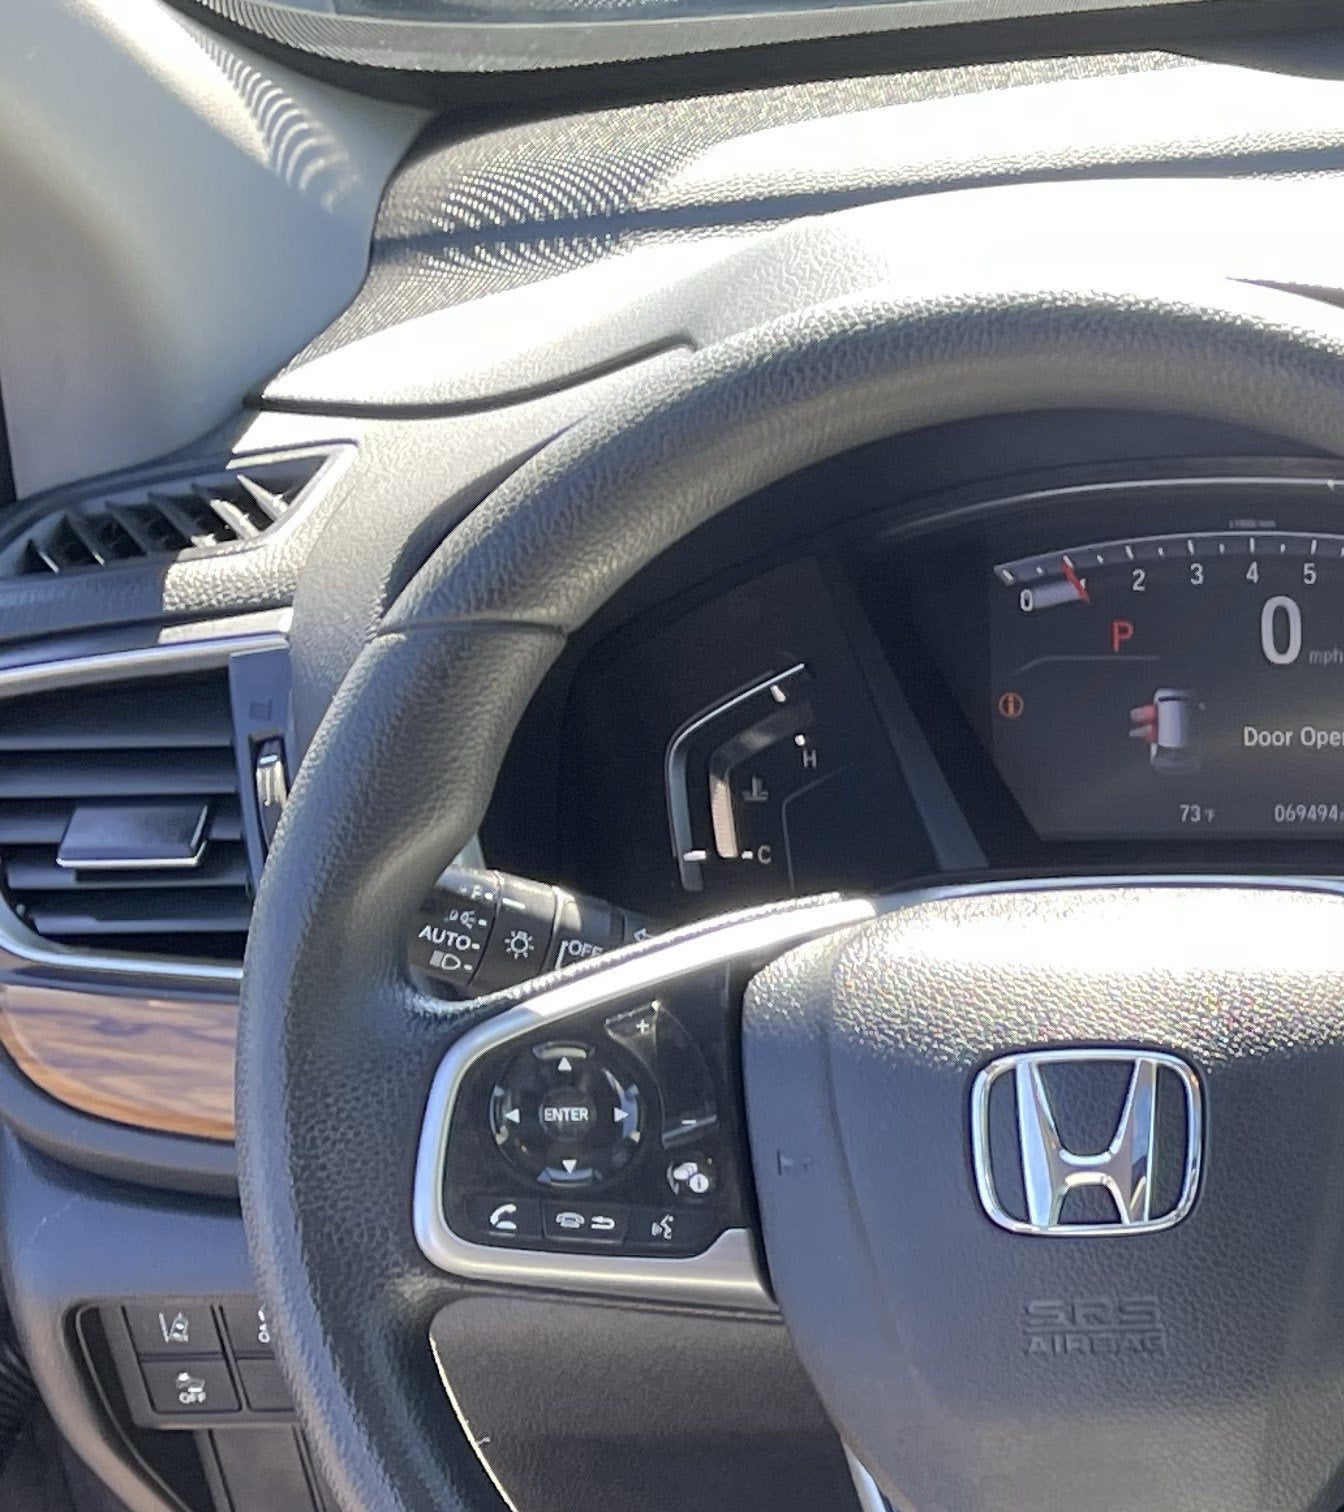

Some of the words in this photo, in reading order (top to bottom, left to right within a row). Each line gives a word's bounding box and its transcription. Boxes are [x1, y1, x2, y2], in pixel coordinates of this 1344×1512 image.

[1020, 589, 1033, 611] 0
[1132, 569, 1146, 591] 2
[1190, 562, 1204, 585] 3
[1245, 561, 1259, 584] 4
[1303, 562, 1317, 585] 5
[1111, 620, 1134, 652] P
[1260, 595, 1302, 665] 0
[1308, 648, 1344, 665] mph
[1244, 726, 1293, 747] Door
[803, 750, 817, 768] H
[1180, 804, 1201, 823] 73
[1274, 804, 1338, 822] 069494
[758, 845, 772, 865] C
[418, 924, 473, 951] AUTO
[543, 1107, 590, 1123] ENTER
[1022, 1298, 1160, 1328] SRS
